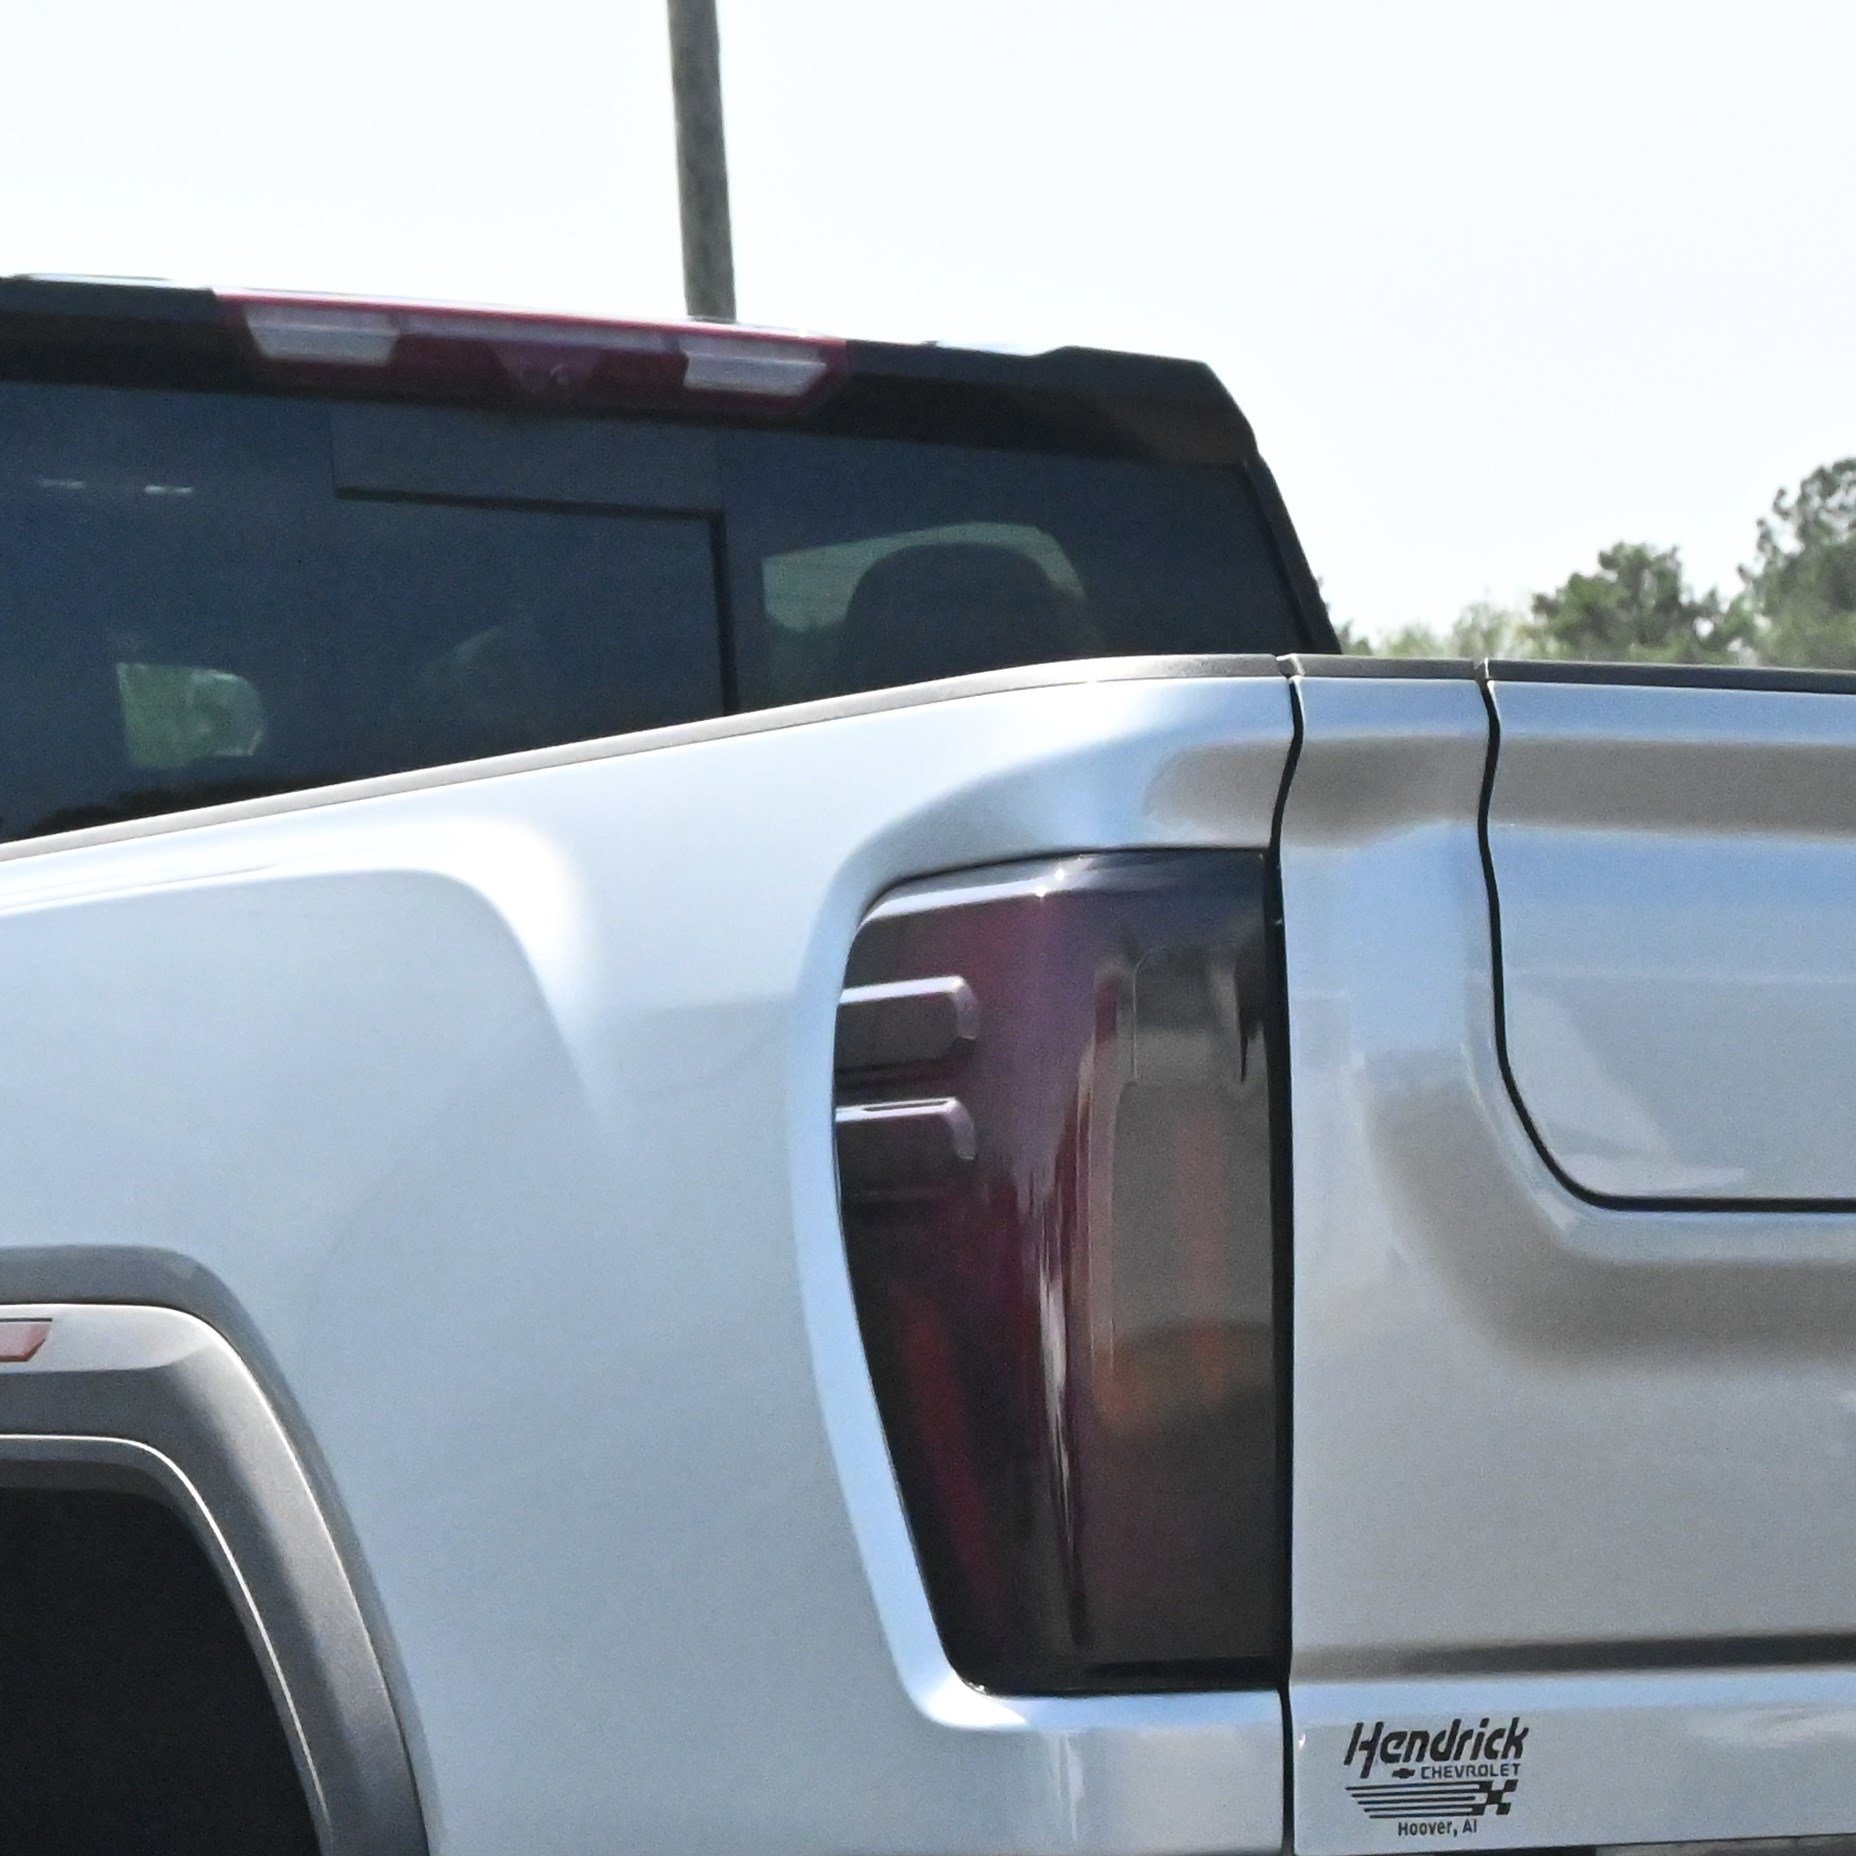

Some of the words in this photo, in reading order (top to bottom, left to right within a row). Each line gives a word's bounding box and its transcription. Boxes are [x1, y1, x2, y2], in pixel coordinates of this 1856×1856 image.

[1343, 1717, 1529, 1779] Hendrick
[1420, 1763, 1521, 1779] CHEVROLET
[1397, 1820, 1458, 1838] Hoover,
